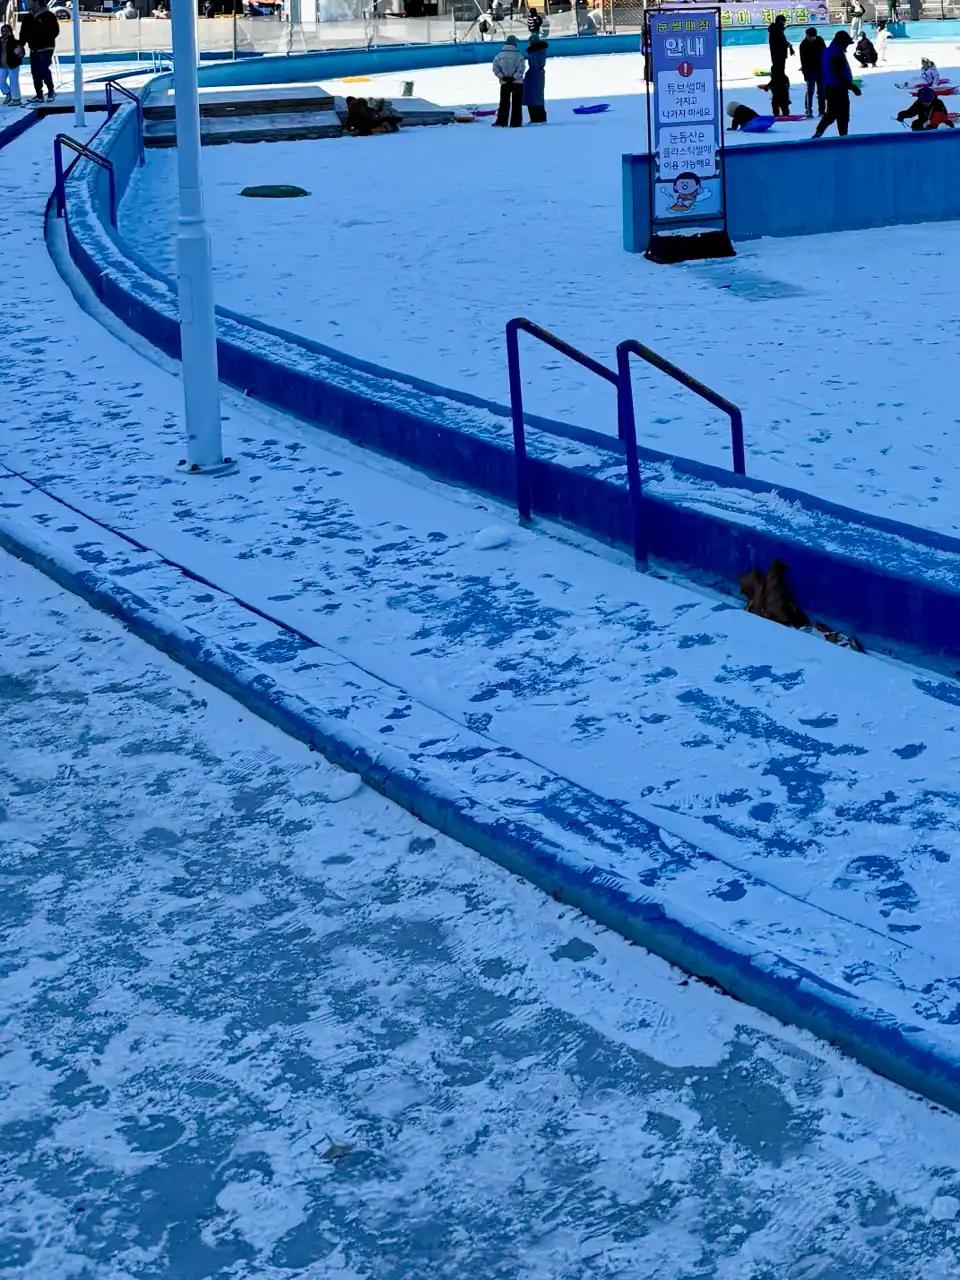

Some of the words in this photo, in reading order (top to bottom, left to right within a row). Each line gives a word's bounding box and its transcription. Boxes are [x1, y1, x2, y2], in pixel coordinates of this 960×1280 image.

[657, 19, 709, 32] 눈썰매장
[666, 37, 704, 57] 안내
[665, 81, 706, 95] 튜브썰매
[676, 97, 698, 106] 가지고
[663, 109, 686, 119] 나가지
[688, 107, 711, 117] 마세요
[670, 131, 705, 144] 눈동산은
[663, 145, 712, 159] 플라스틱썰매
[664, 160, 679, 171] 이용
[681, 159, 712, 171] 가능해요
